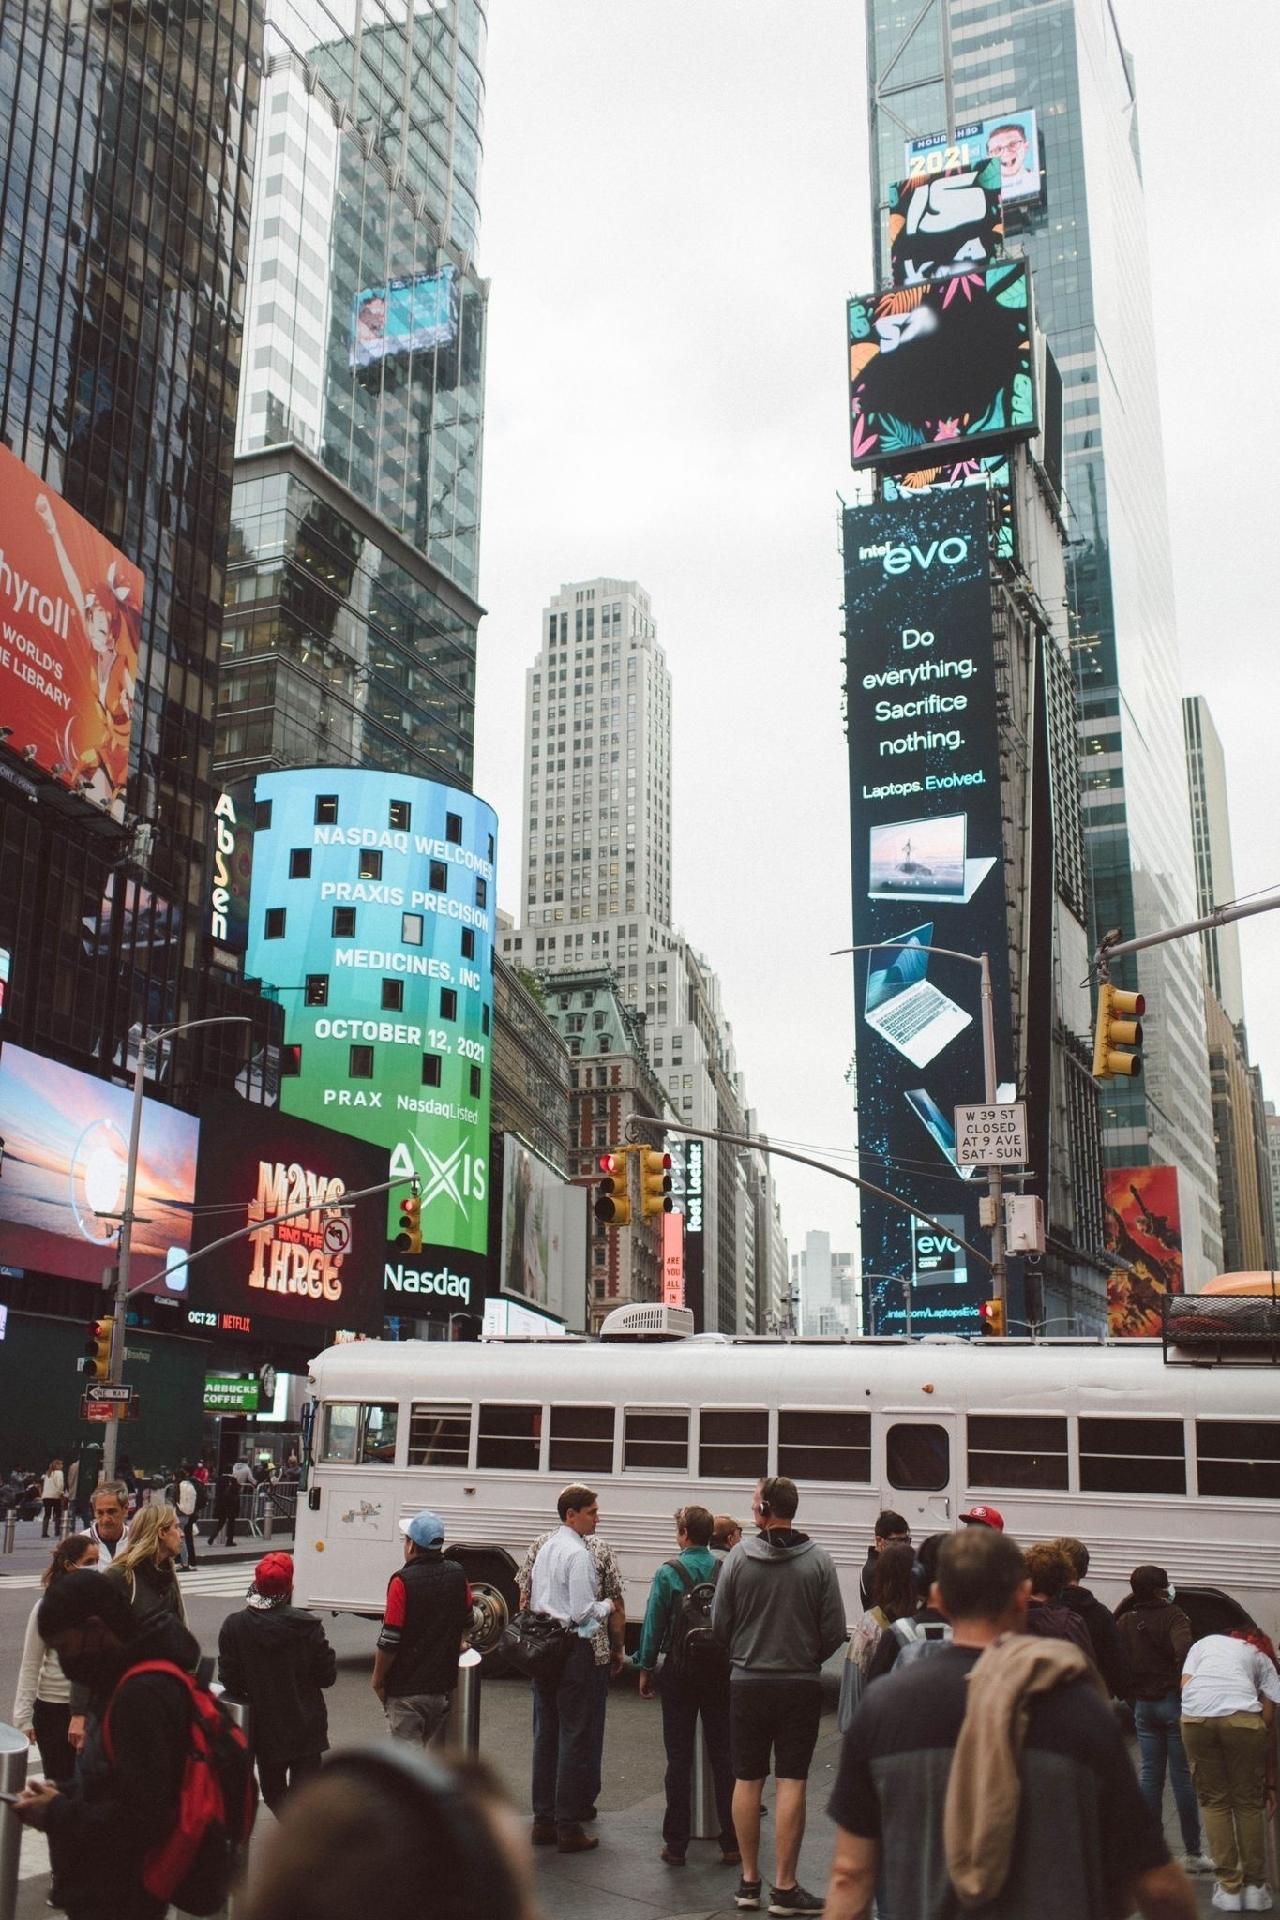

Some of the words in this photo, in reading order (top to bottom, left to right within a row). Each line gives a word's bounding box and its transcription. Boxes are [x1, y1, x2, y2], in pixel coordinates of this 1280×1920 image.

[910, 144, 970, 177] 2021
[859, 541, 892, 560] intel
[883, 537, 968, 574] evo
[2, 621, 64, 681] WORLD'S
[902, 629, 935, 649] Do
[13, 657, 72, 711] LIBRARY
[863, 658, 978, 689] everything.
[875, 694, 968, 722] Sacrifice
[880, 729, 966, 757] nothing.
[863, 781, 923, 800] Laptops.
[926, 770, 986, 790] Evolved.
[211, 793, 237, 941] Absen
[313, 827, 409, 855] NASDAQ
[414, 836, 493, 881] WELCOMES
[320, 882, 404, 906] PRAXIS
[411, 891, 489, 933] PRECISION
[335, 948, 455, 984] MEDICINES,
[459, 967, 481, 992] INC
[314, 1018, 422, 1046] OCTOBER
[428, 1029, 452, 1054] 12,
[457, 1037, 485, 1063] 2021
[323, 1089, 383, 1108] PRAX
[966, 1112, 975, 1121] W
[980, 1111, 996, 1120] 39
[1000, 1109, 1016, 1119] ST
[962, 1136, 978, 1147] AT
[983, 1136, 990, 1146] 9
[995, 1135, 1021, 1145] AVE
[966, 1122, 1016, 1134] CLOSED
[686, 1143, 702, 1194] Locker
[686, 1197, 702, 1232] Foot
[248, 1222, 343, 1300] THREE
[383, 1264, 470, 1306] Nasdaq
[188, 1311, 205, 1326] OCT
[205, 1312, 217, 1327] 22
[223, 1313, 251, 1332] NETFLIX
[203, 1393, 245, 1404] COFFEE
